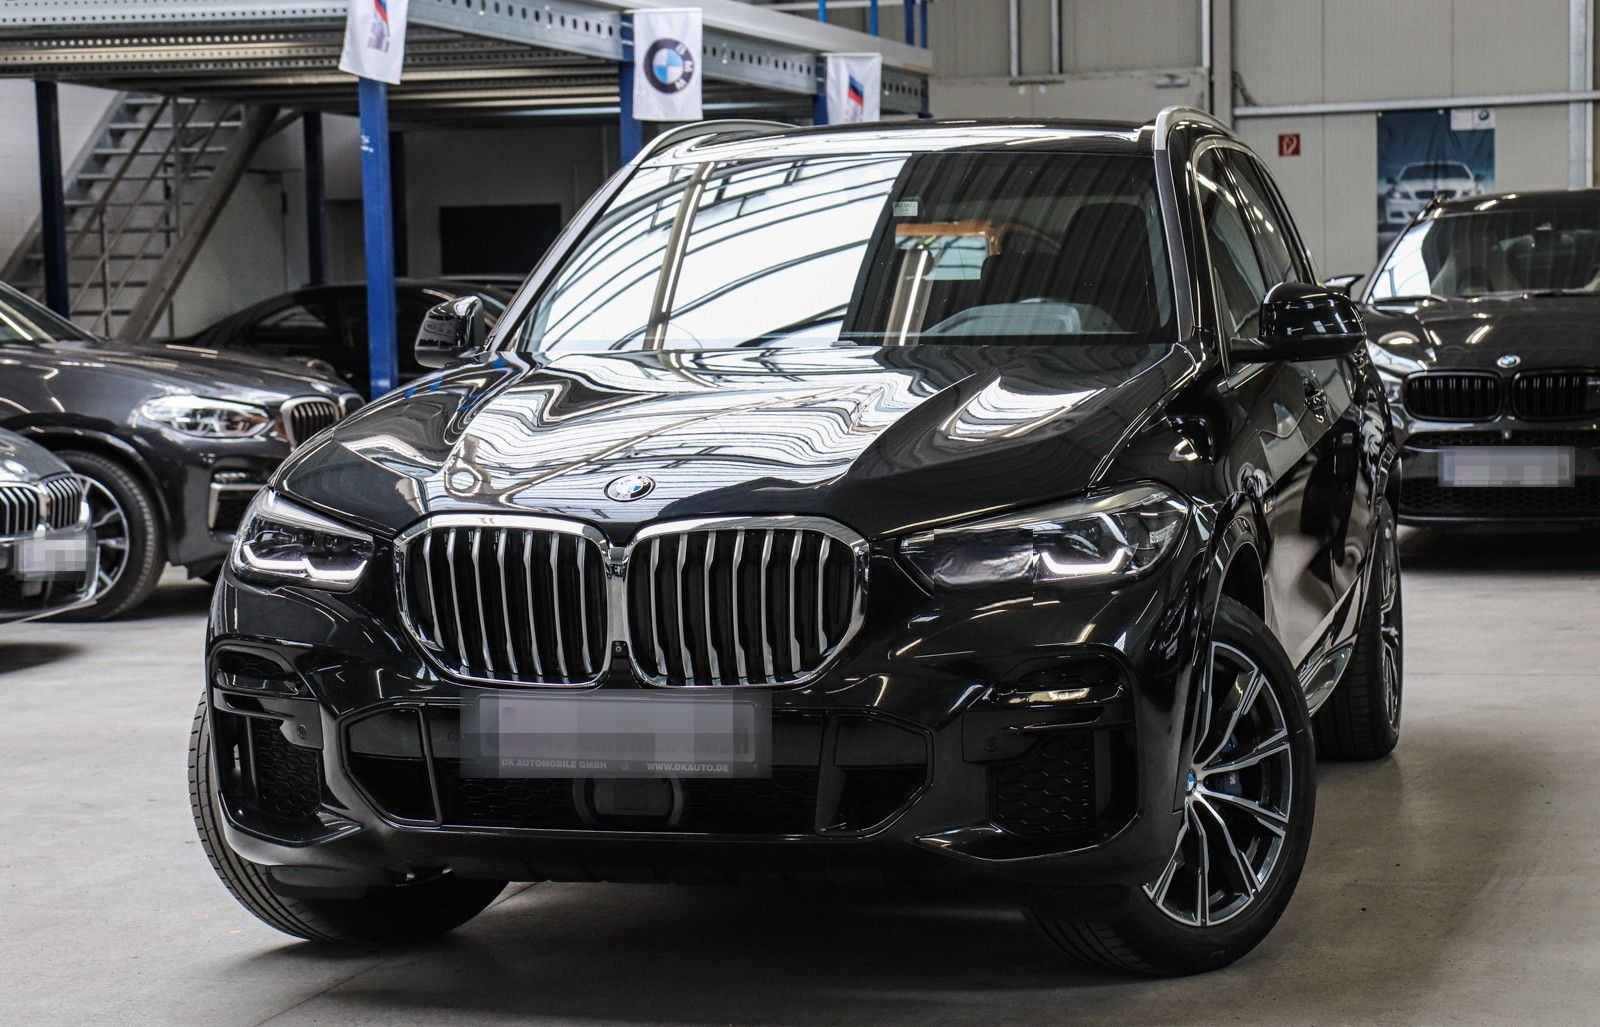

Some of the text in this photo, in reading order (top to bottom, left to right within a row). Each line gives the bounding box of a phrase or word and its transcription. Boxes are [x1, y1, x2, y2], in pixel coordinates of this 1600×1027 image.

[501, 758, 515, 767] DK
[516, 759, 577, 769] AUTOMOBILE
[578, 760, 607, 770] GMBH
[646, 762, 729, 773] WWW.DKAUTO.DE
